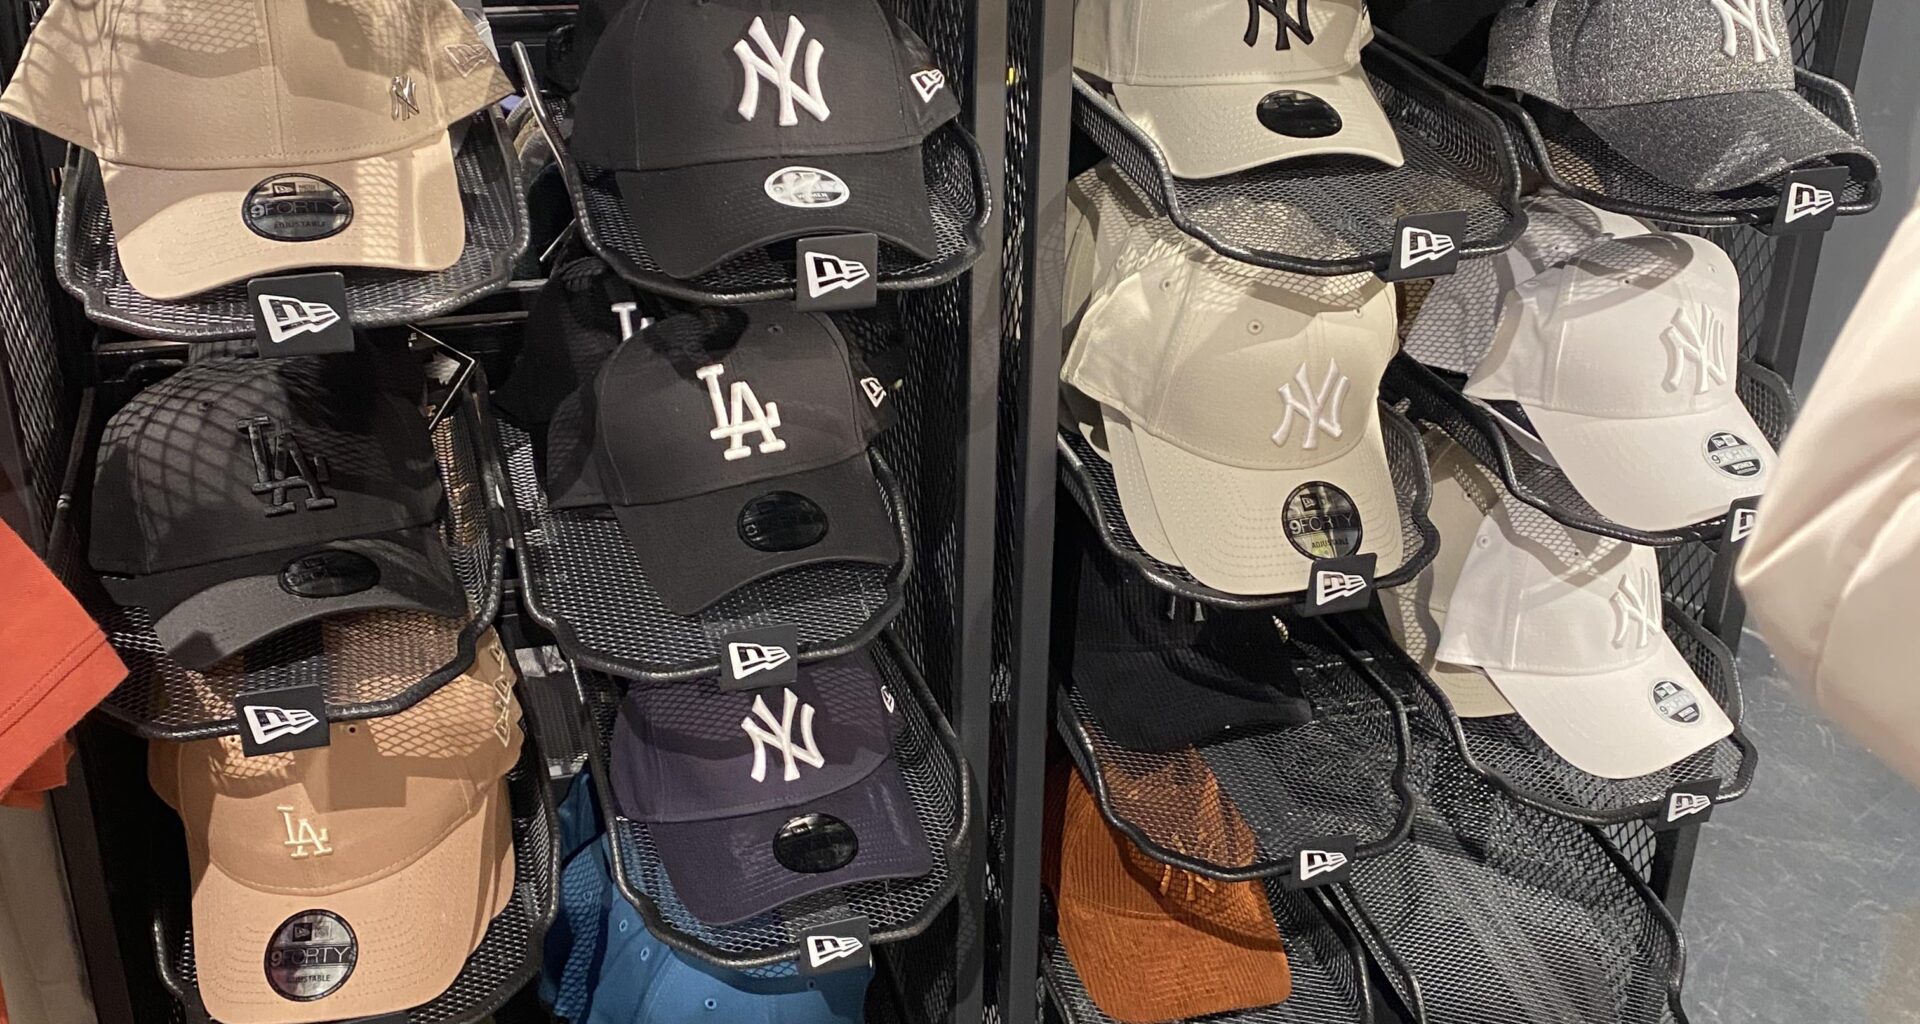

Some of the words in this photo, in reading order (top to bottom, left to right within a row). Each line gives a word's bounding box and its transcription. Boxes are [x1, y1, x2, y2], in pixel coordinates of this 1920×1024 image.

[733, 15, 831, 127] NY
[1659, 303, 1727, 395] NY
[696, 363, 786, 461] LA
[1270, 357, 1351, 450] NY
[236, 416, 337, 518] LA
[1609, 567, 1660, 649] NY
[741, 688, 825, 783] NY
[276, 805, 333, 859] LA
